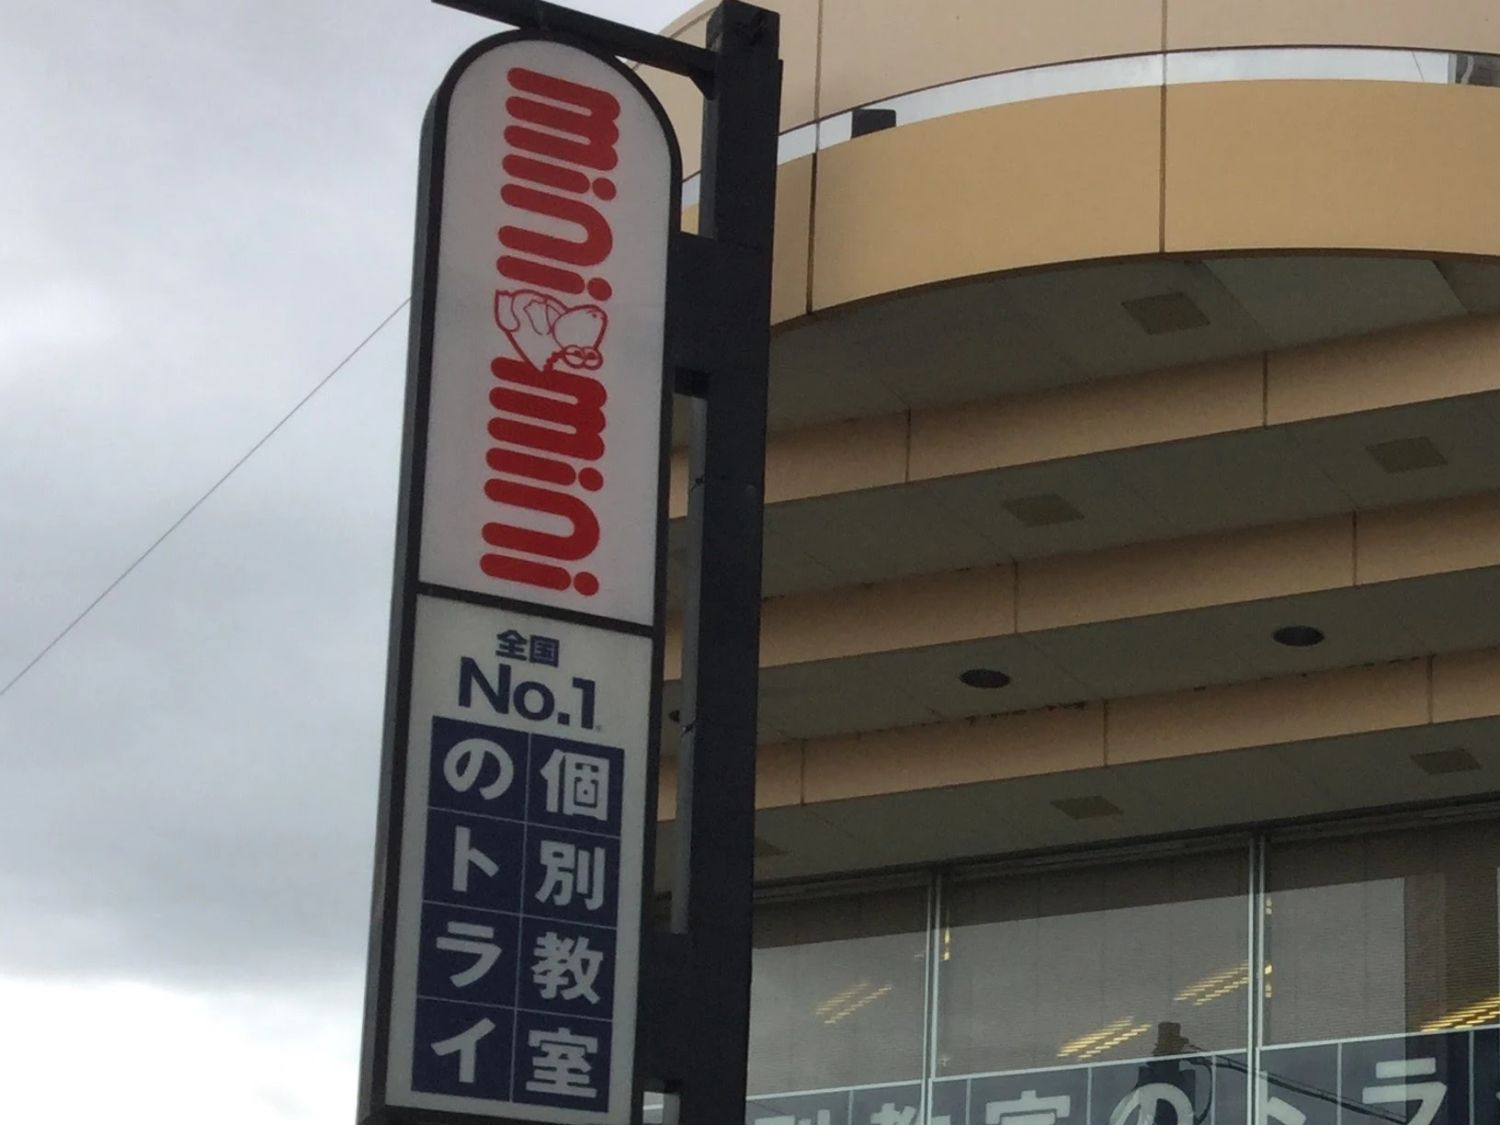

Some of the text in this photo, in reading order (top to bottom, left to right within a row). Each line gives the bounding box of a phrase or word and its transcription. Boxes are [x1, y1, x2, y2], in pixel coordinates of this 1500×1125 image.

[497, 67, 620, 301] mini
[457, 656, 596, 730] No.1
[494, 629, 560, 668] 全国
[429, 737, 515, 1084] のトライ
[526, 748, 611, 1099] 個別教室
